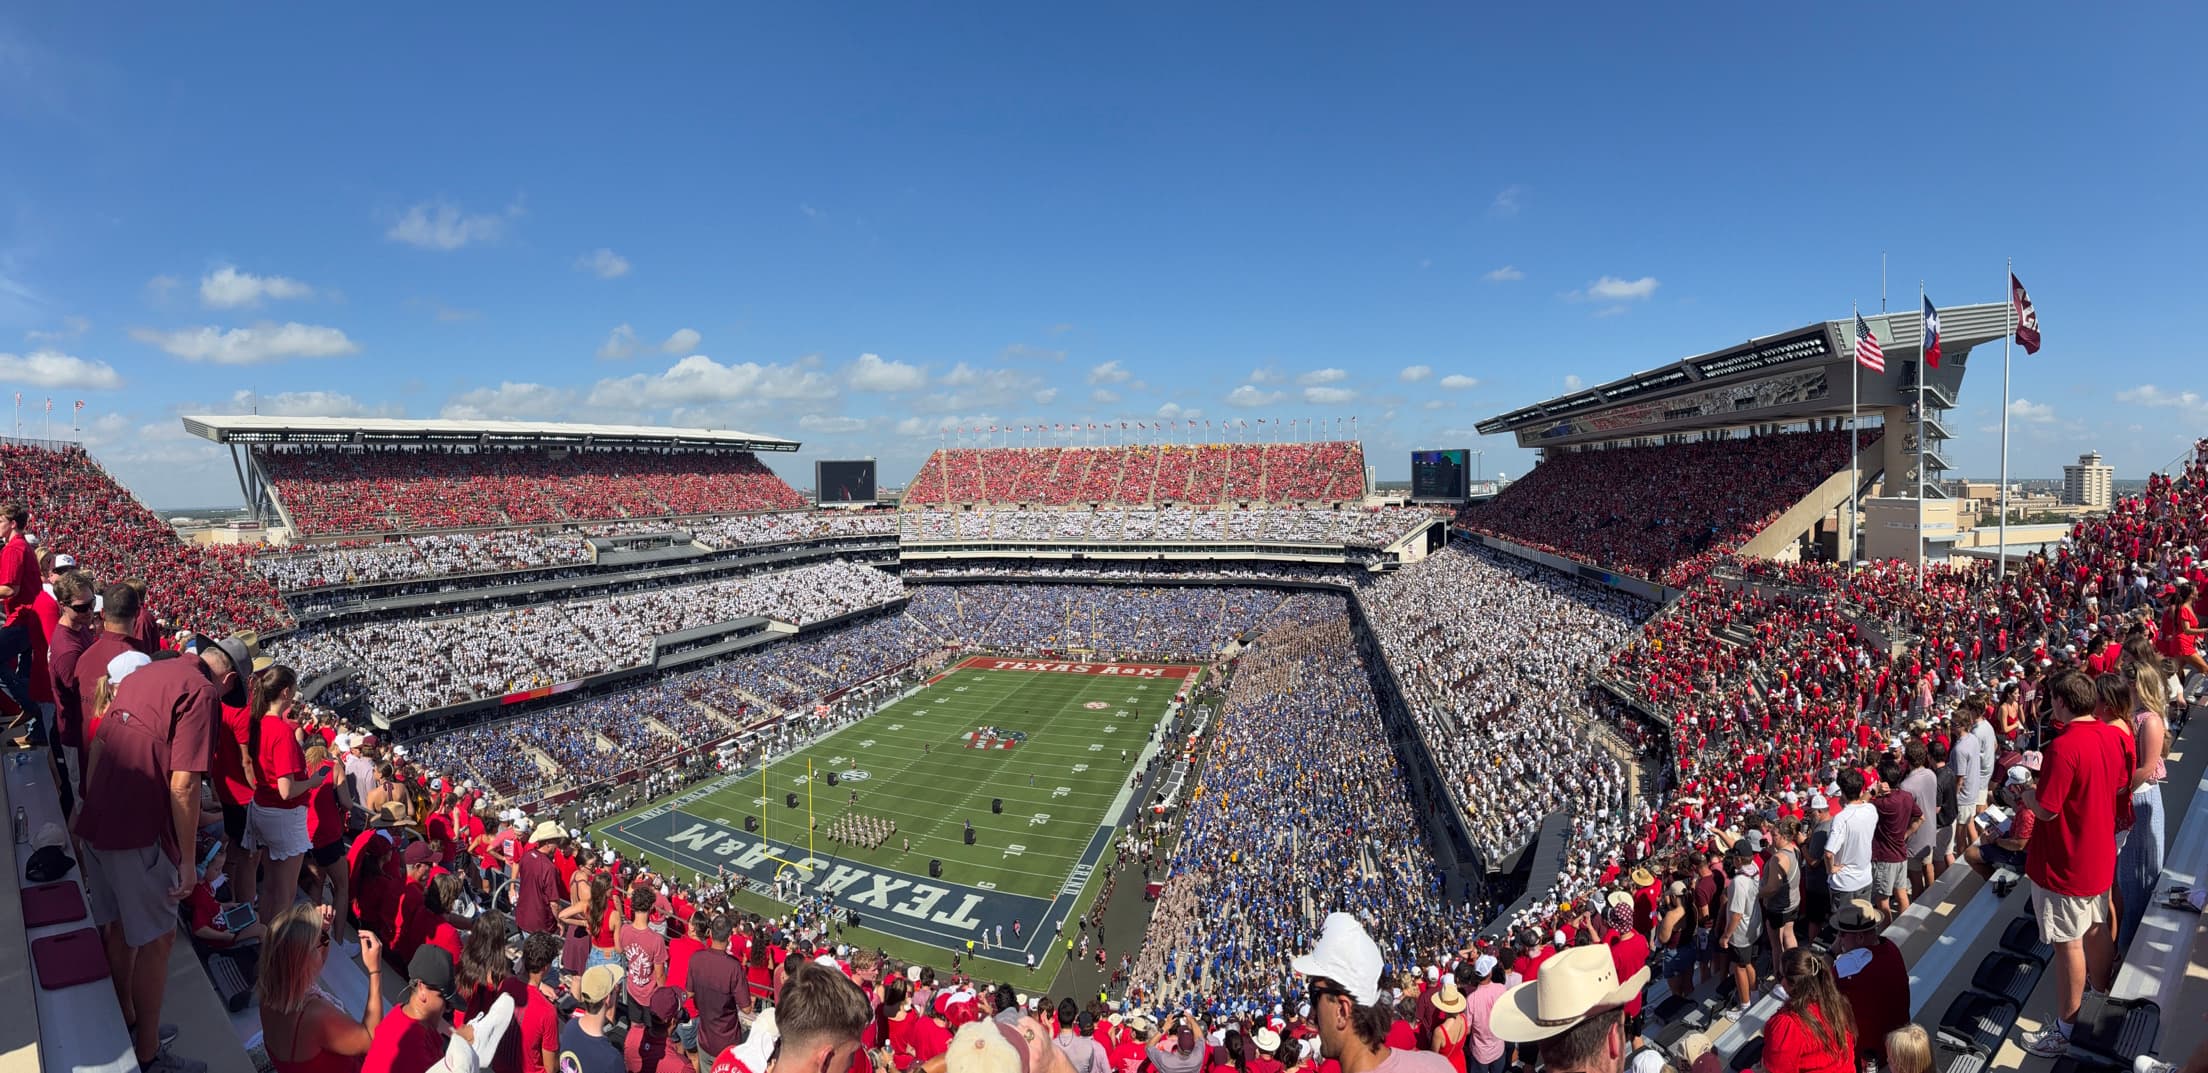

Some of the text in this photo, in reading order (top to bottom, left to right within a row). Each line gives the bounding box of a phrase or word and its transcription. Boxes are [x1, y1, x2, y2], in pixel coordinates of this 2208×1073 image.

[993, 661, 1165, 677] TEXAS A&M
[1031, 813, 1051, 825] 20
[665, 823, 787, 869] A&M
[1004, 844, 1027, 856] 10
[1063, 864, 1093, 896] GRIND
[780, 857, 984, 930] TEXAS
